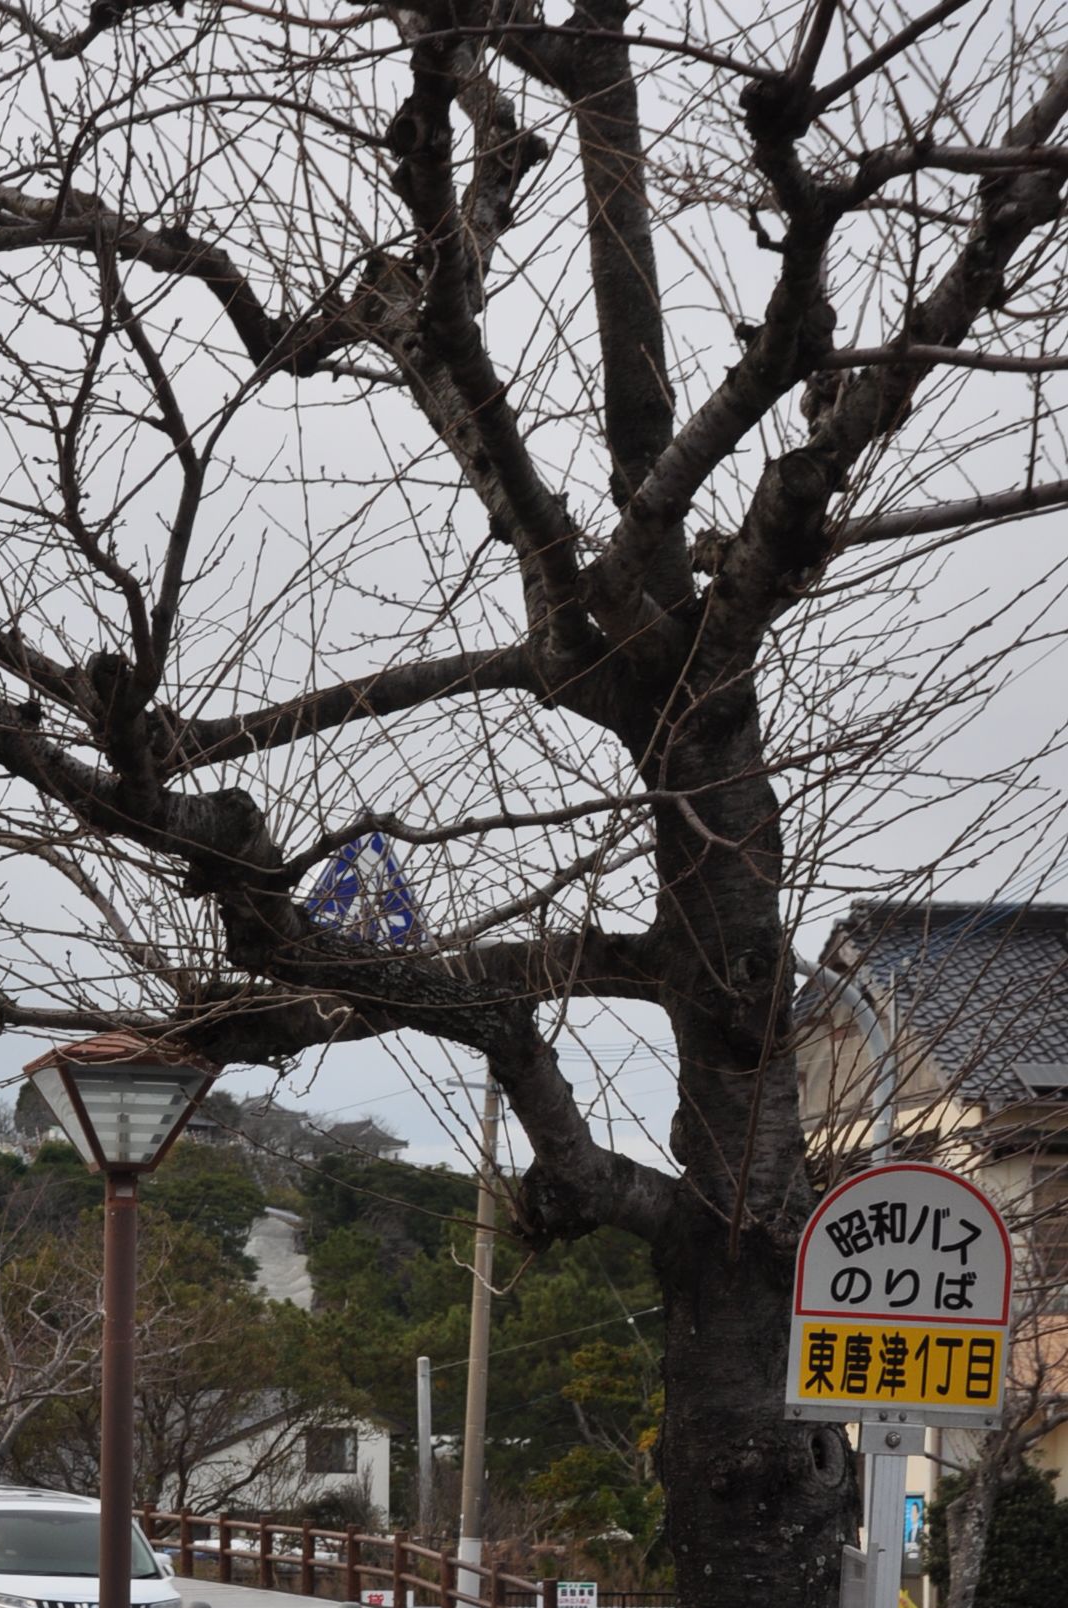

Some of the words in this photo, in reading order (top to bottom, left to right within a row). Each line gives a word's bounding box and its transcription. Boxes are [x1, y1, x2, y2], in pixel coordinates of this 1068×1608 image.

[825, 1200, 982, 1266] 昭和バス
[830, 1266, 978, 1311] のりば
